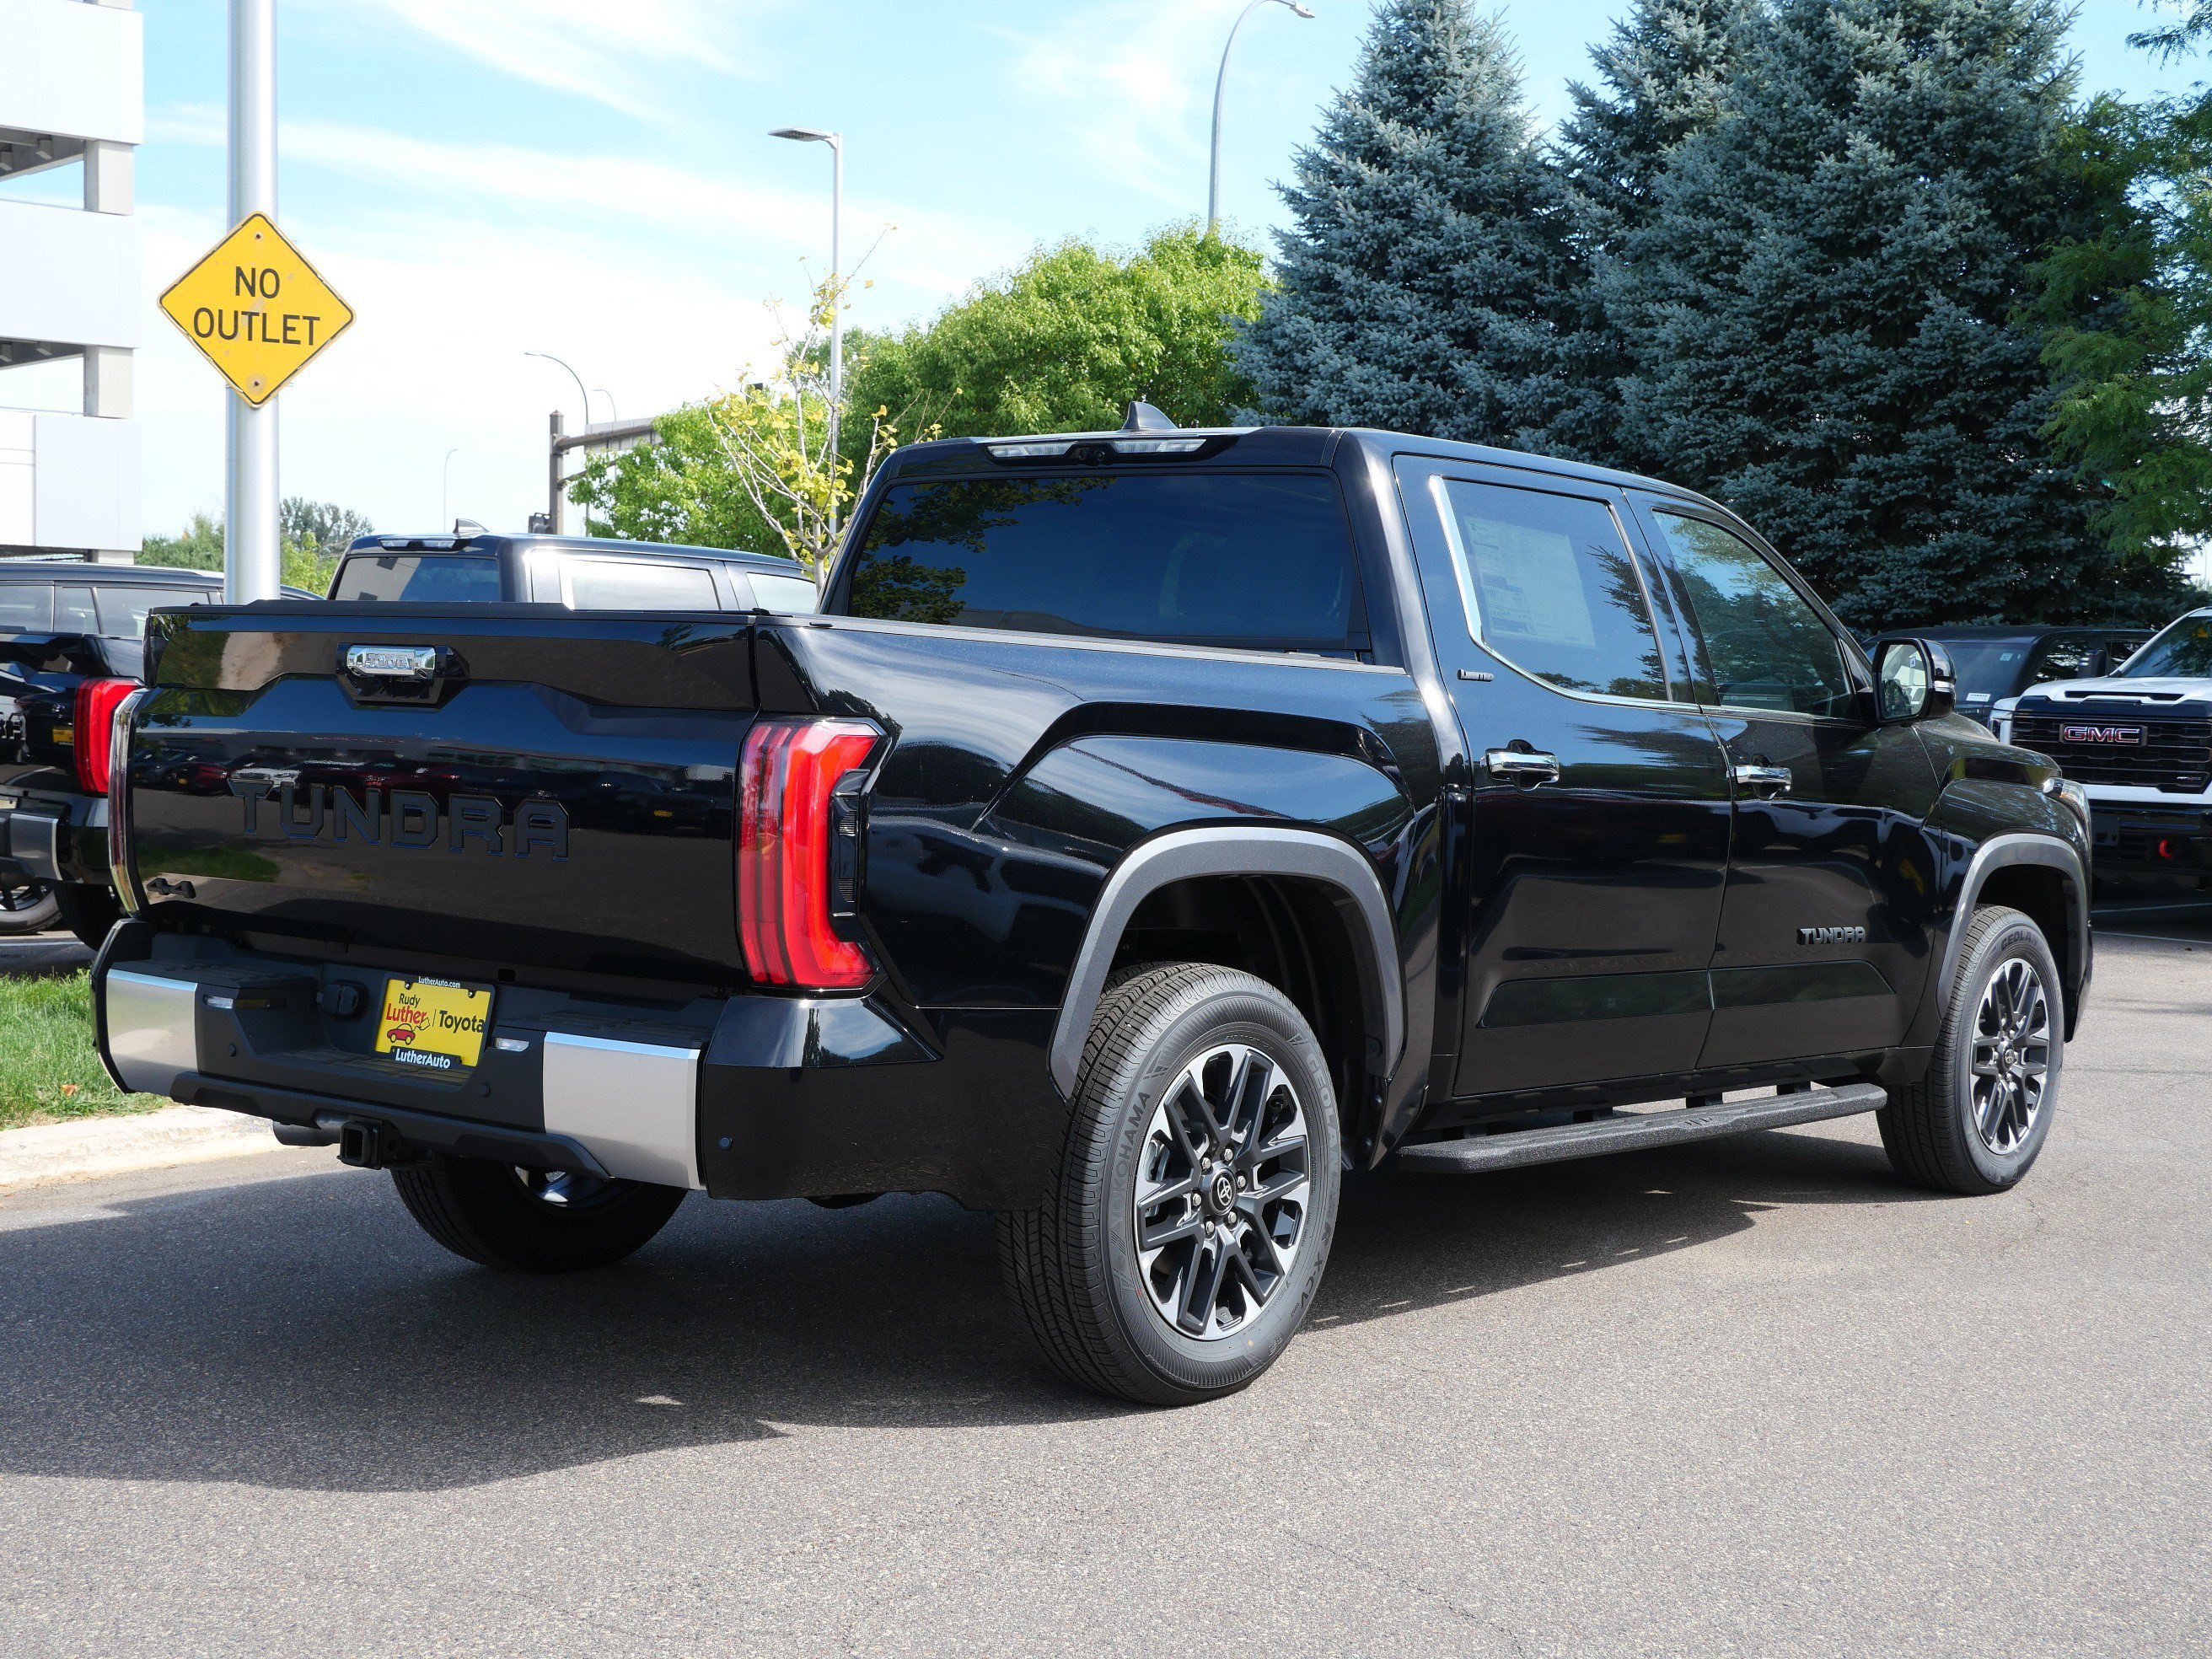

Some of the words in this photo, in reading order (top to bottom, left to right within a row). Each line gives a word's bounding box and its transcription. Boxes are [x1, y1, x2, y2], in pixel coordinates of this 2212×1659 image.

[235, 266, 280, 299] NO
[193, 307, 320, 346] OUTLET
[2064, 726, 2140, 744] GMC
[227, 777, 570, 862] TUNDRA
[1796, 926, 1866, 945] TUNDRA
[418, 975, 461, 989] LutherAuto.com
[399, 992, 421, 1008] Rudy
[386, 1002, 427, 1024] Luther
[439, 1010, 485, 1034] Toyota
[395, 1048, 451, 1069] LutherAuto
[1110, 1091, 1152, 1228] YOKOHAMA
